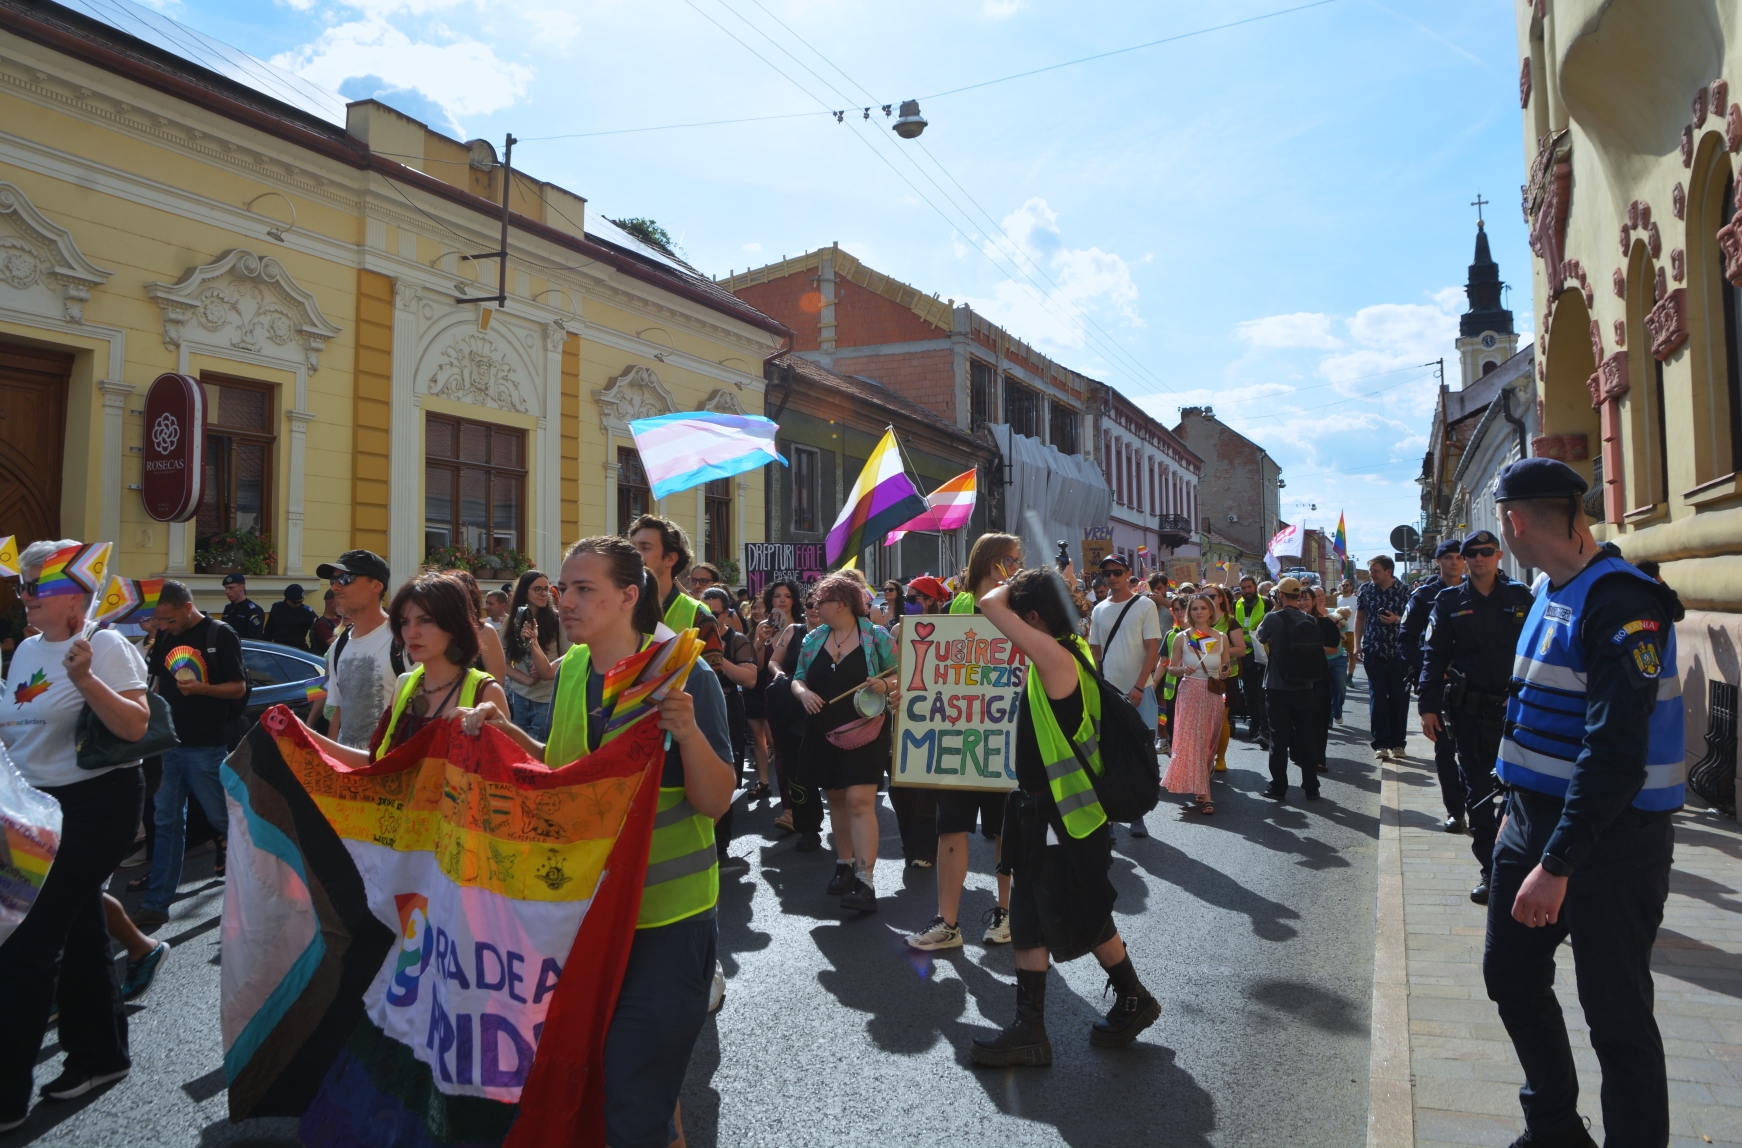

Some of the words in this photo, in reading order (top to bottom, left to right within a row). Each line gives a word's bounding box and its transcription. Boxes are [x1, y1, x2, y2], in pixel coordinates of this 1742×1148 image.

[146, 459, 184, 470] ROSECAS
[1083, 525, 1115, 541] VREM
[748, 543, 795, 571] DREPTURI
[795, 544, 823, 570] EGALE
[1613, 620, 1656, 643] ROMANIA
[303, 750, 314, 794] ORADEA
[514, 775, 537, 786] RIOT
